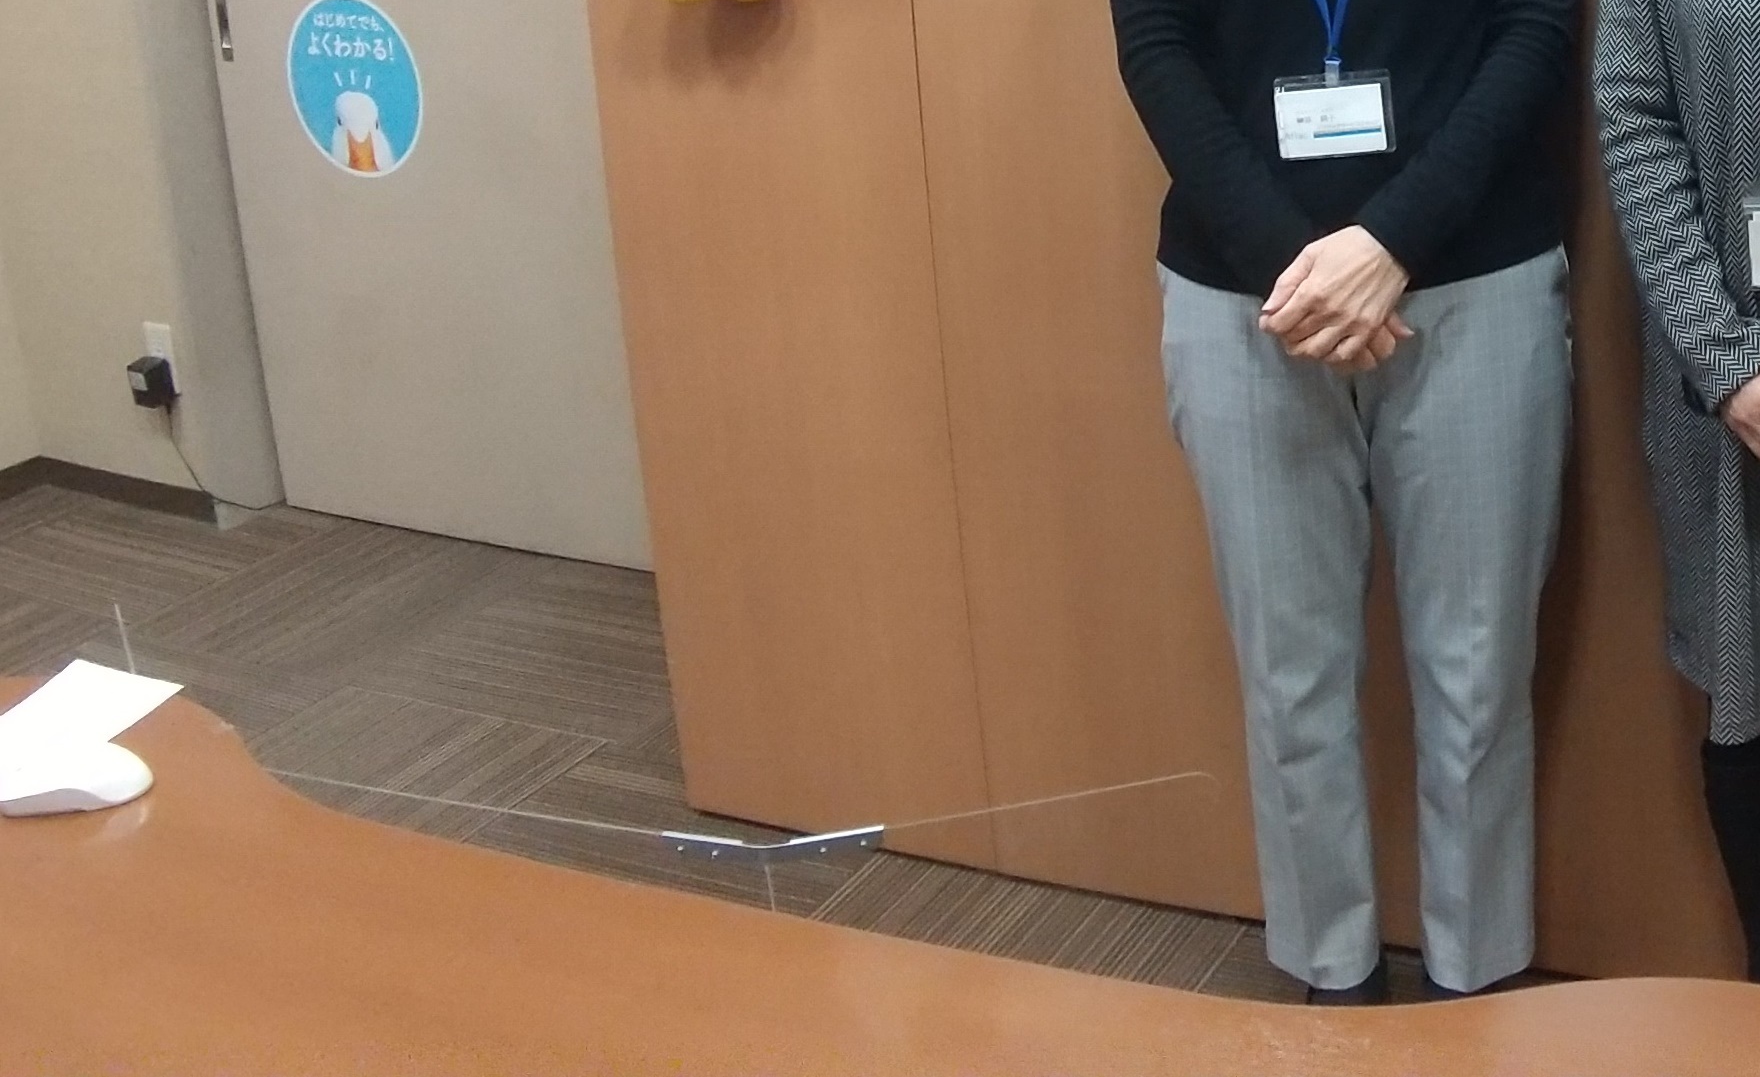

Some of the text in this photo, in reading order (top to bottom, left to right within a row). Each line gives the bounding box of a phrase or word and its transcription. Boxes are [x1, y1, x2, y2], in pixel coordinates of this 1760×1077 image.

[307, 31, 395, 61] よくわかる!
